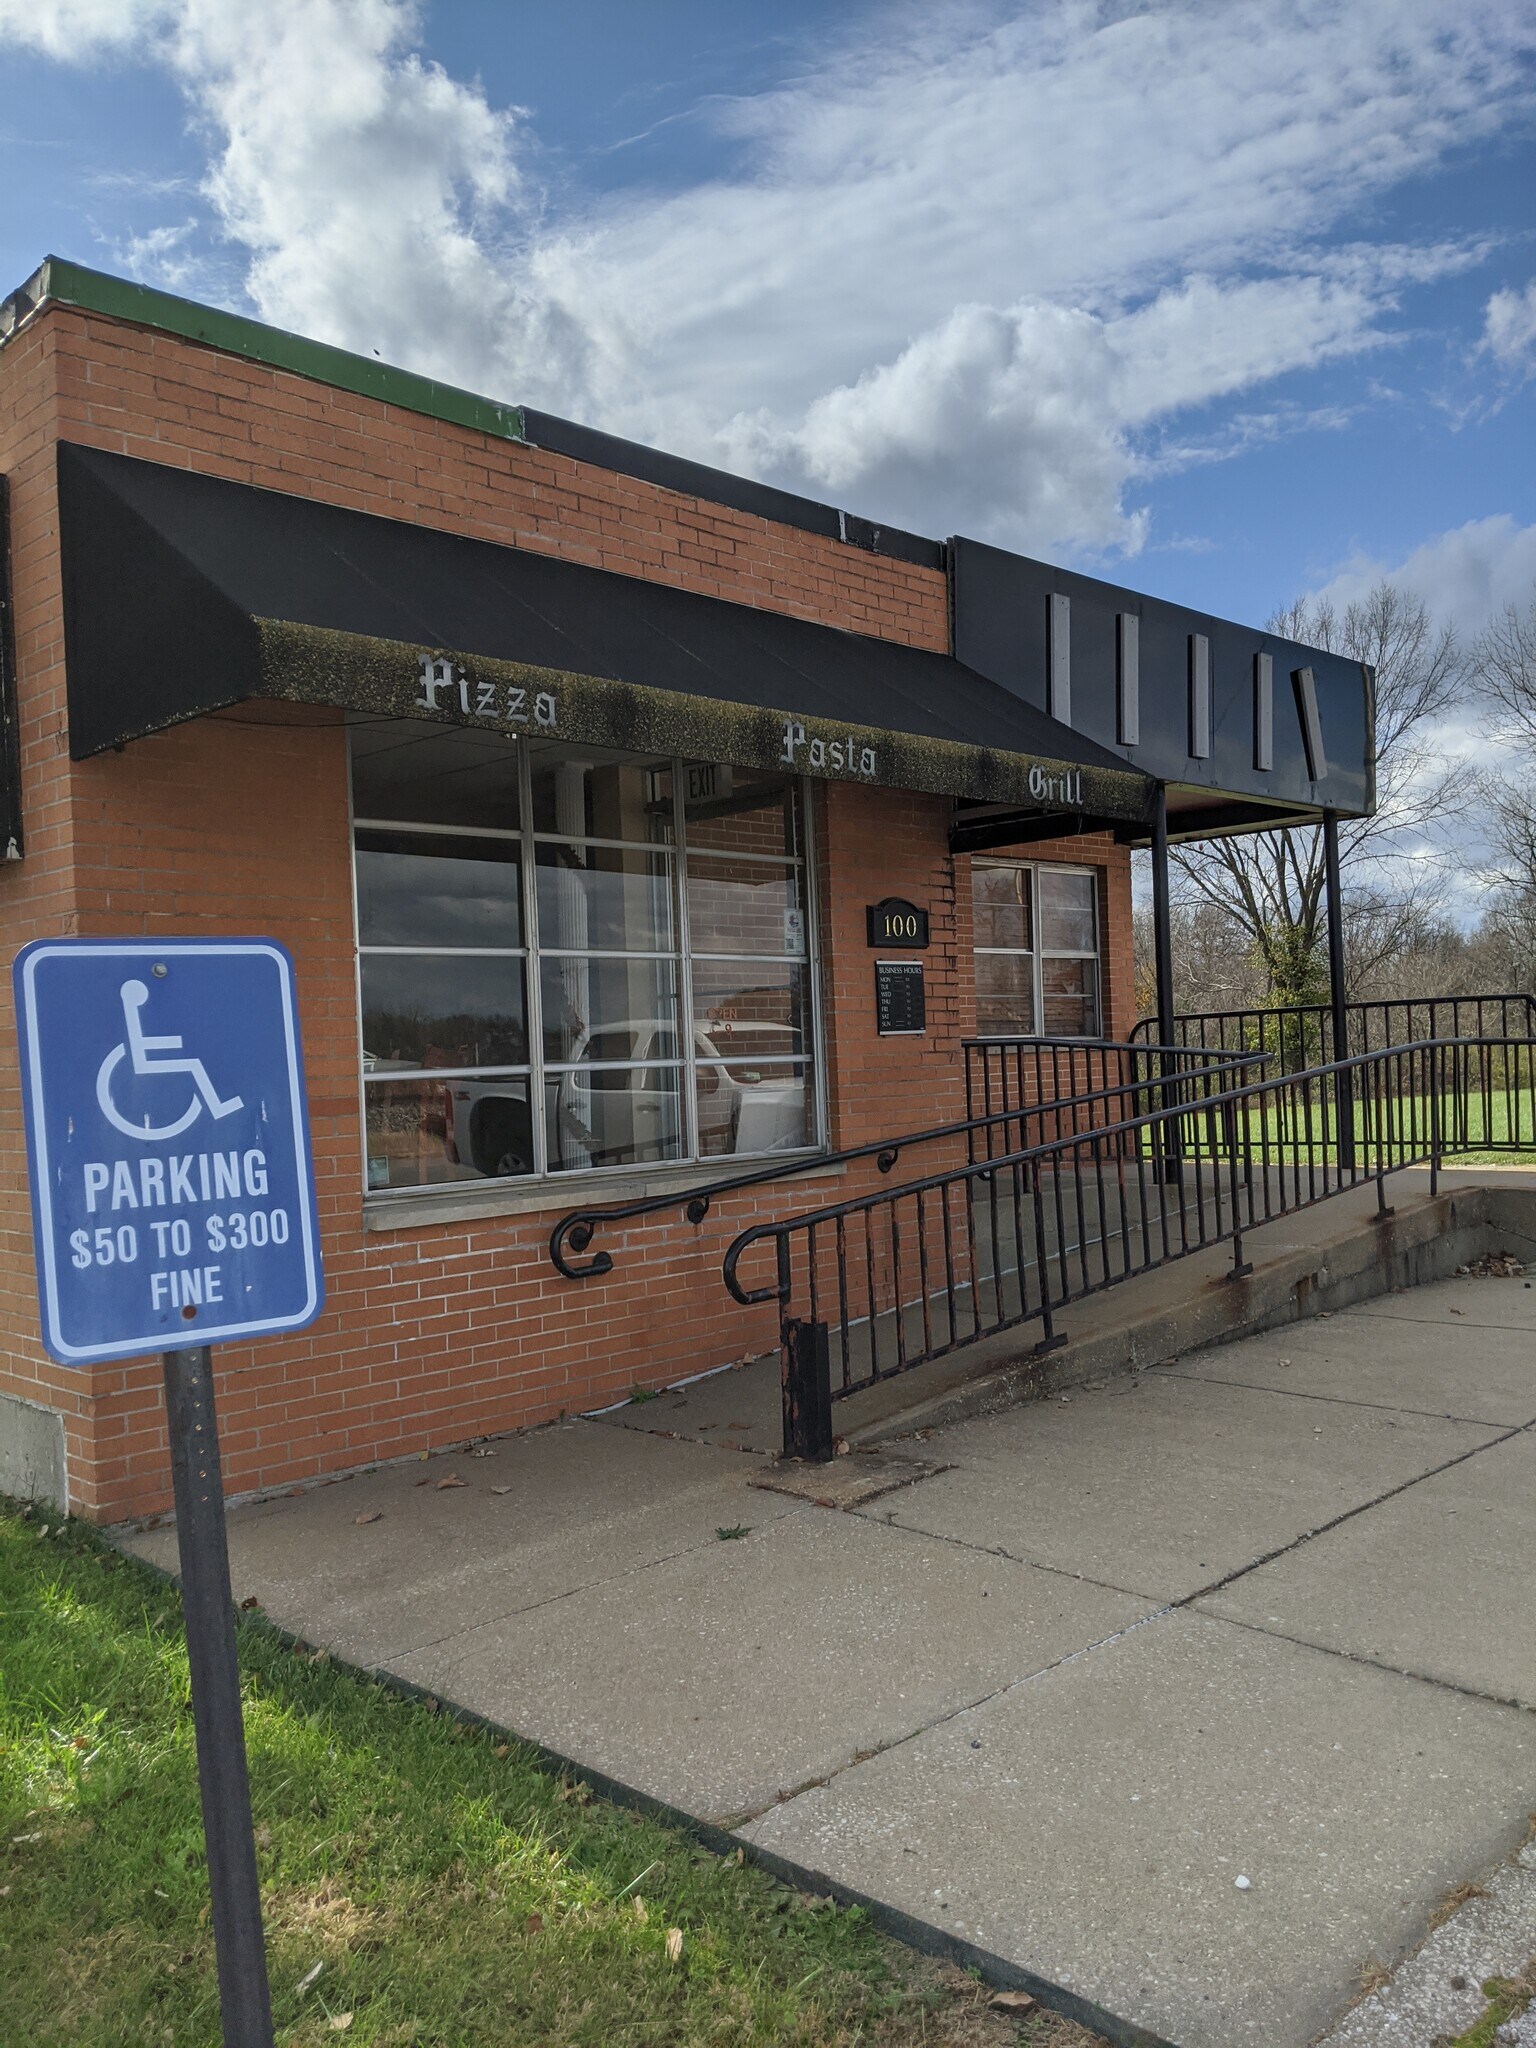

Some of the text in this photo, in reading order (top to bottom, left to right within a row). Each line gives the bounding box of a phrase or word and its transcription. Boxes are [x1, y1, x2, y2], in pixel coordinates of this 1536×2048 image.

[415, 653, 557, 727] Pizza
[780, 718, 877, 777] Pasta
[688, 764, 716, 798] EXIT
[1028, 764, 1084, 805] Grill
[884, 915, 917, 937] 100
[878, 966, 922, 975] BUSINESS HOURS
[83, 1149, 269, 1213] PARKING
[70, 1208, 289, 1269] $50 TO $300
[150, 1266, 223, 1310] FINE
